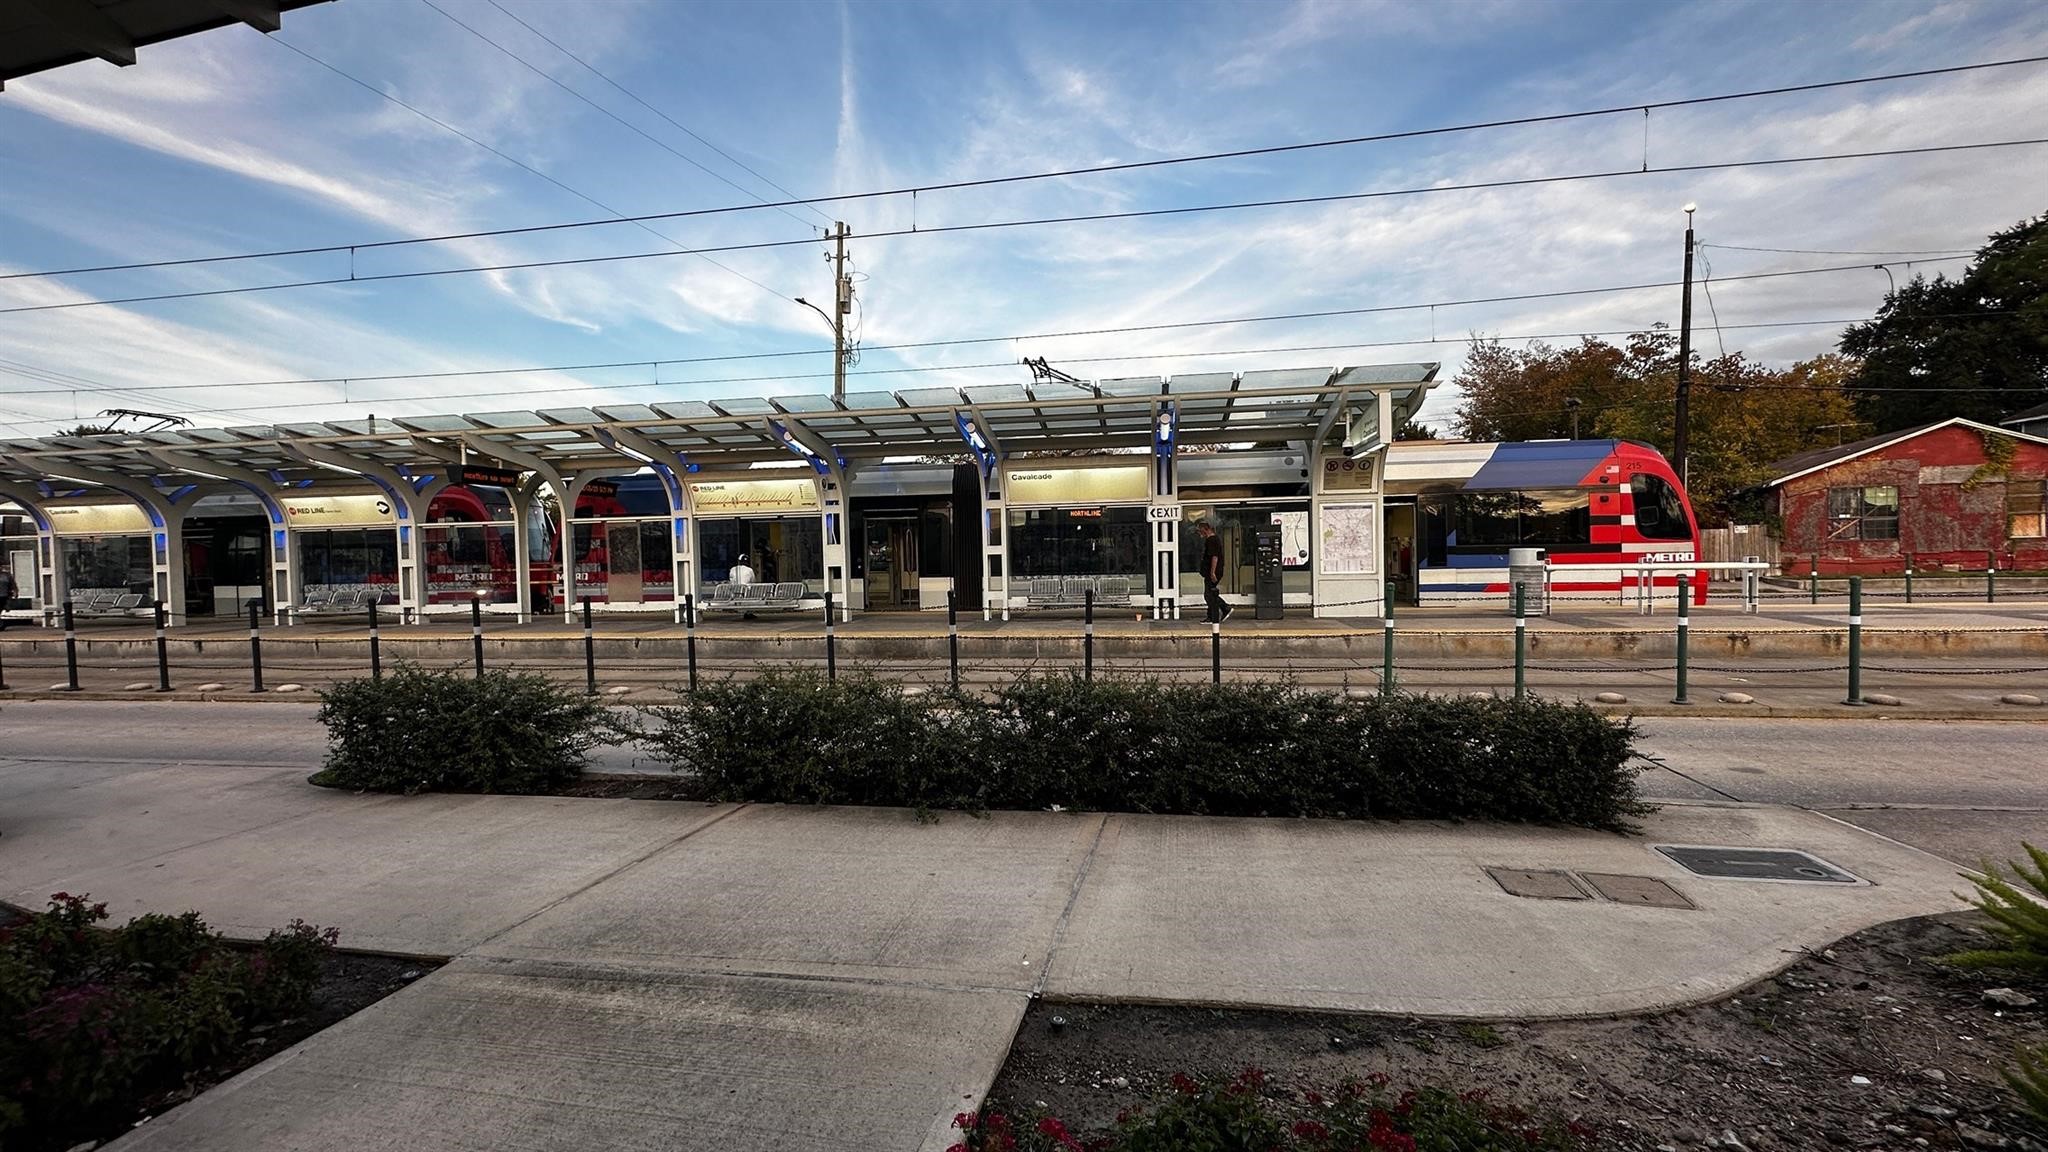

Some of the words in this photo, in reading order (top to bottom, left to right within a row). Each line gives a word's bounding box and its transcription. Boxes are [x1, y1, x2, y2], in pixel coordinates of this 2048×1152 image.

[1626, 462, 1641, 470] 215
[1156, 507, 1179, 518] EXIT
[1646, 552, 1695, 562] METRO
[455, 573, 493, 581] METRO
